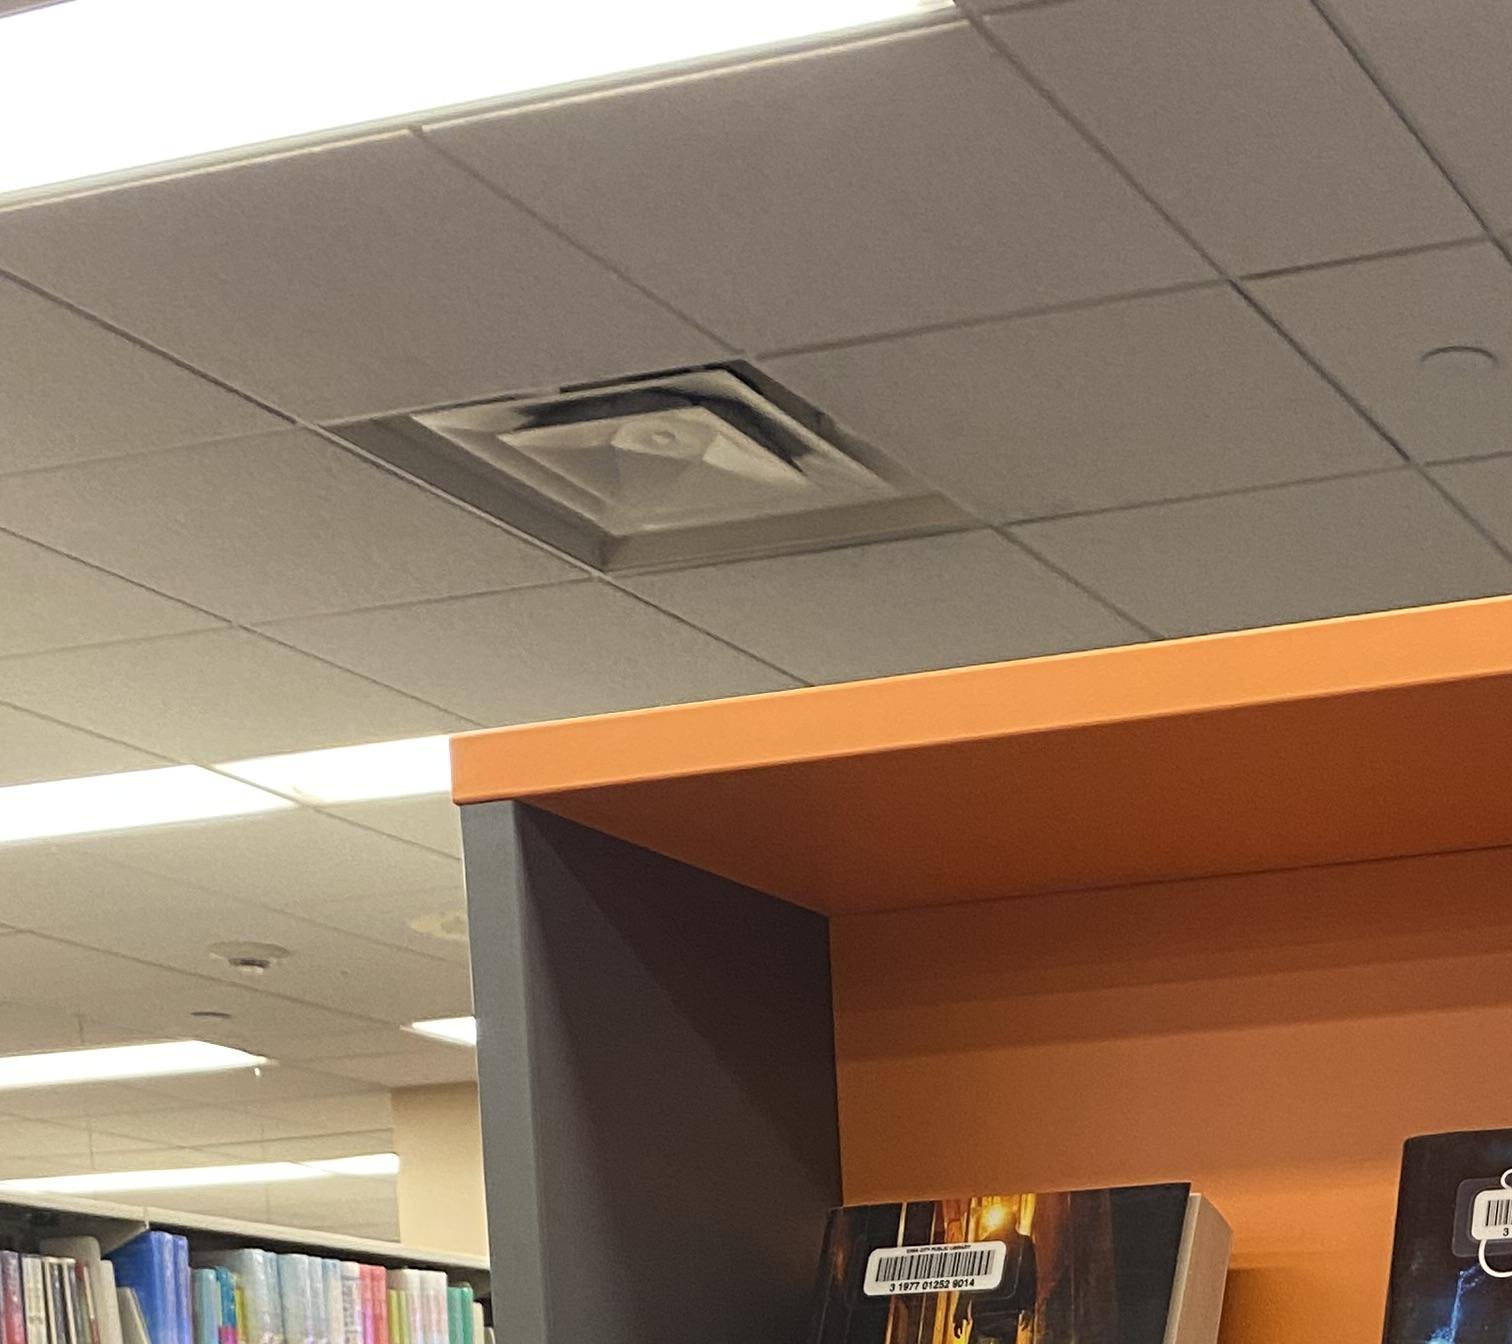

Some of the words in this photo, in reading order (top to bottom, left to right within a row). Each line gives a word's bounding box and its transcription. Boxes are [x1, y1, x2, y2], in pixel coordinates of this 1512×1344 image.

[1503, 1227, 1509, 1236] 3
[889, 1283, 895, 1292] 3
[898, 1282, 920, 1291] 1977
[922, 1280, 950, 1290] 01252
[952, 1278, 975, 1288] 9014
